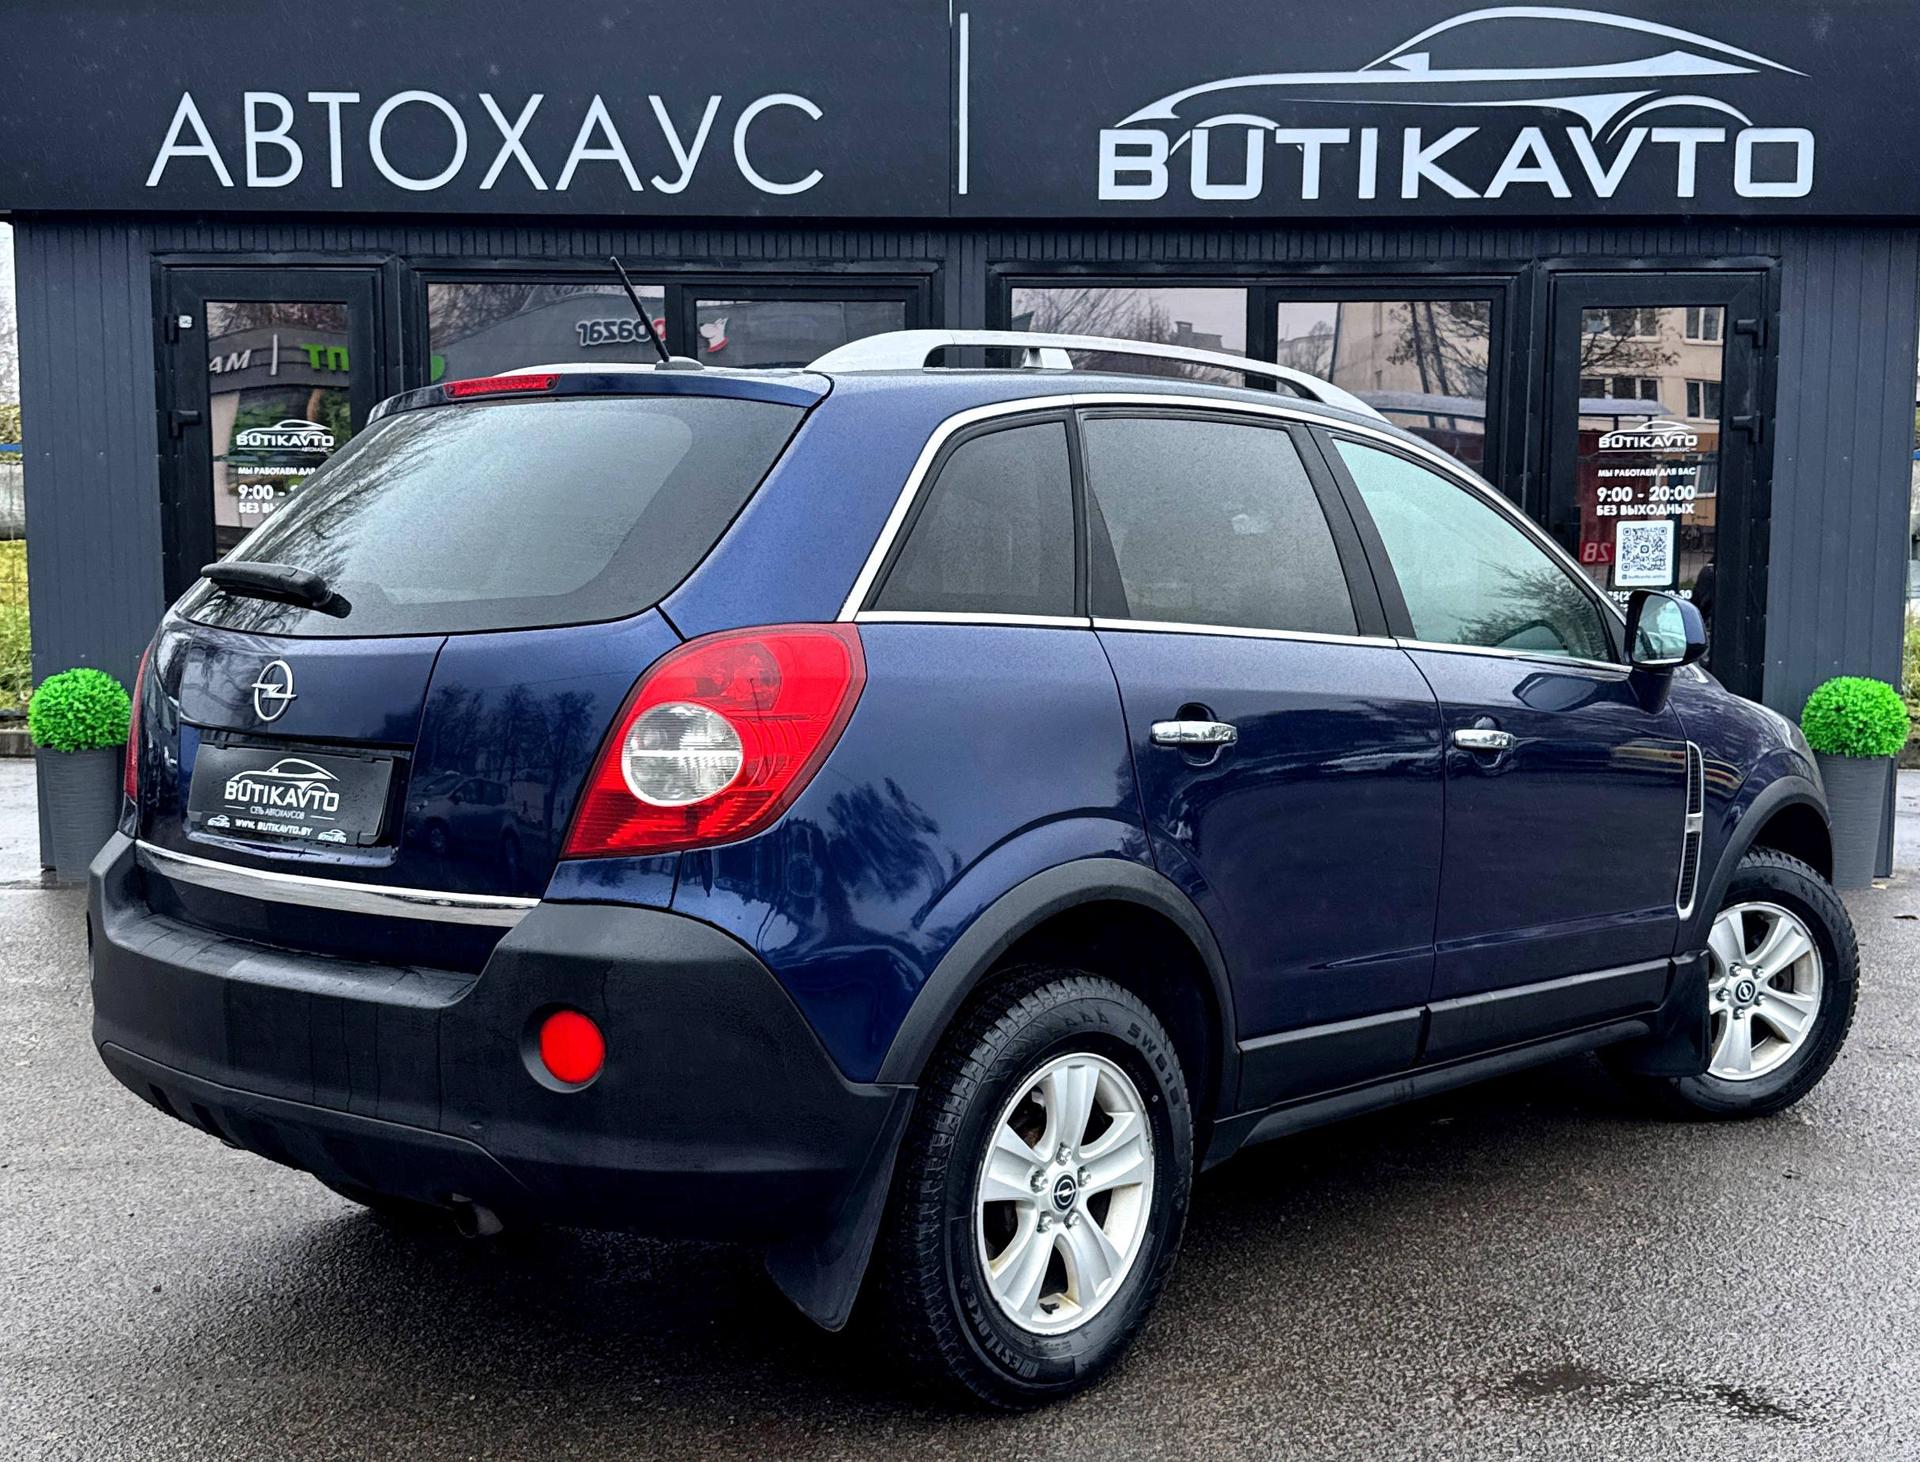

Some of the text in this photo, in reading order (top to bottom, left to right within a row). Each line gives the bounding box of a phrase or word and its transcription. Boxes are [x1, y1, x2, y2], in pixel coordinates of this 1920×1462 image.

[145, 90, 824, 195] АВТОХАУС
[1098, 126, 1815, 200] BUTIKAVTO
[236, 434, 335, 447] BUTIKAVTO
[1598, 435, 1698, 448] BUTIKAVTO
[237, 467, 253, 475] МЫ
[254, 467, 298, 475] РАБОТАЕМ
[1597, 467, 1696, 477] МЫ РАБОТАЕМ ДЛЯ ВАС
[238, 484, 274, 500] 9:00
[1596, 486, 1633, 502] 9:00
[1648, 485, 1696, 502] 20:00
[238, 502, 259, 514] БЕЗ
[1596, 503, 1695, 516] БЕЗ ВЫХОДНЫХ
[224, 780, 340, 812] BUTIKAVTO
